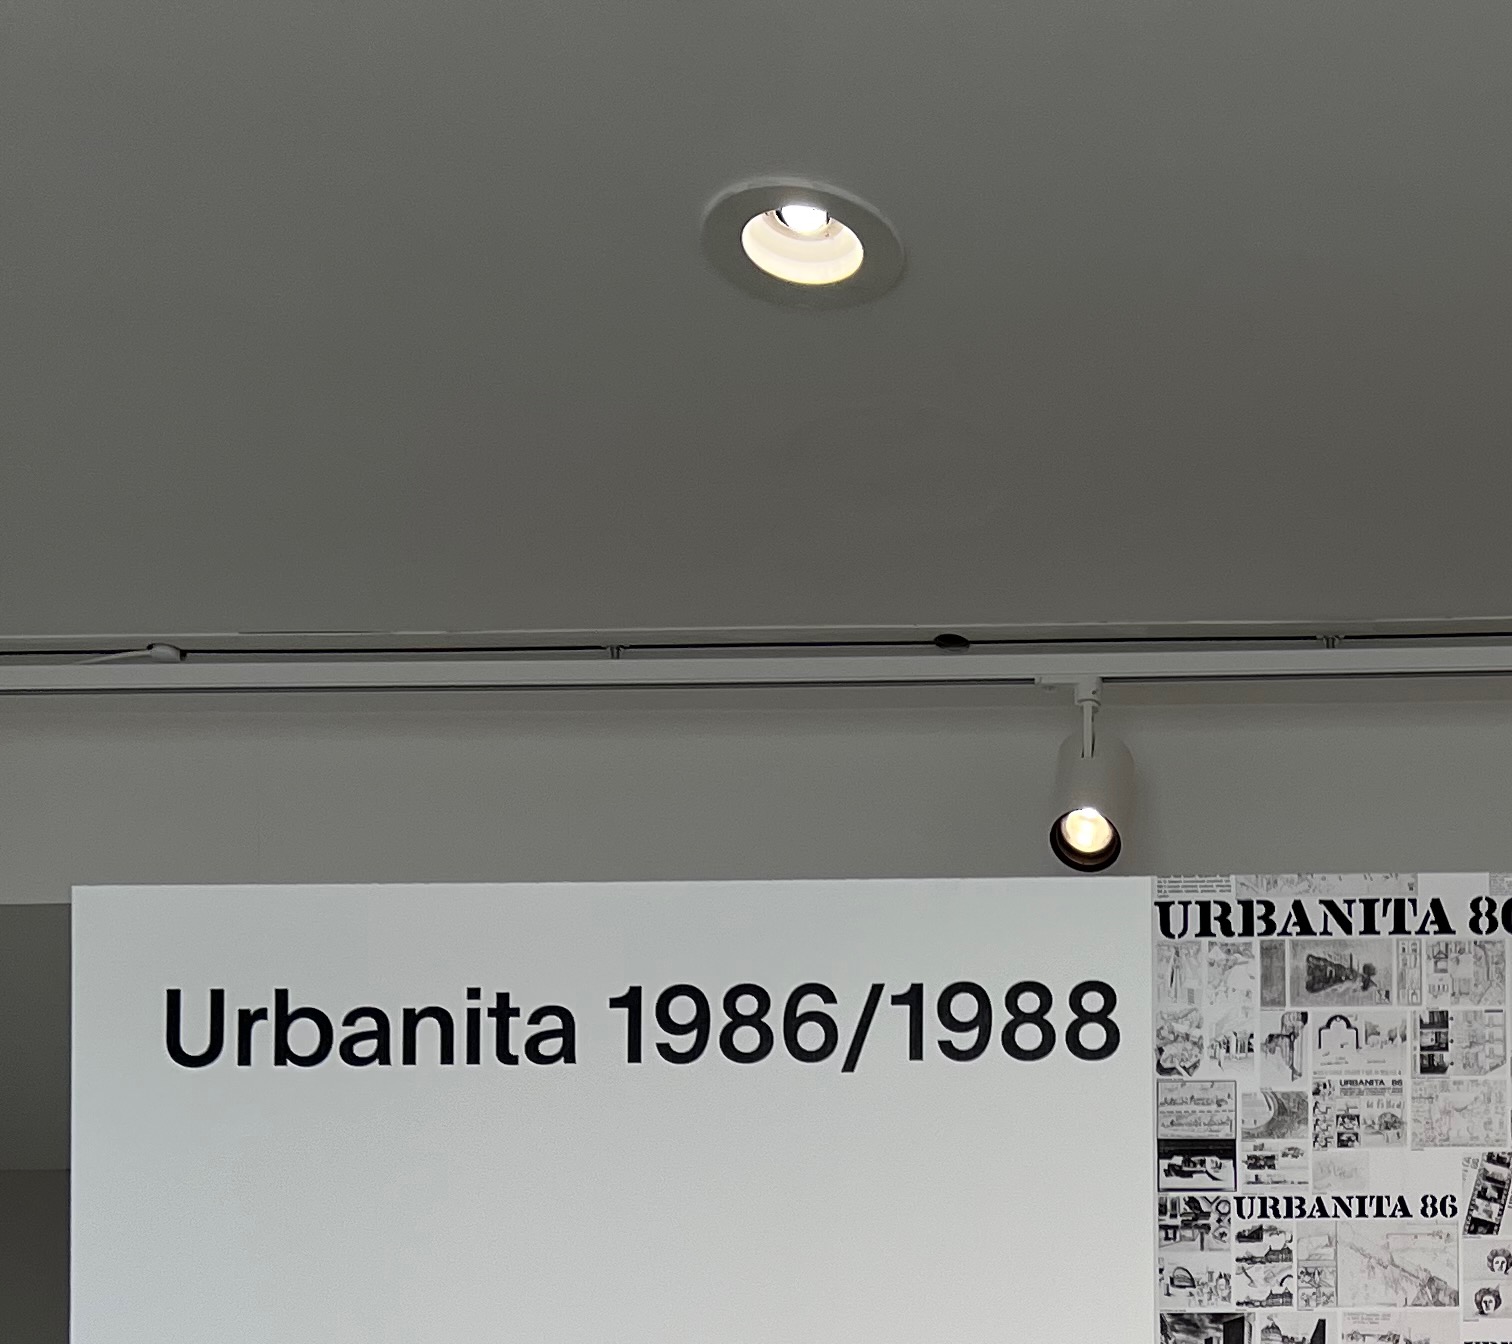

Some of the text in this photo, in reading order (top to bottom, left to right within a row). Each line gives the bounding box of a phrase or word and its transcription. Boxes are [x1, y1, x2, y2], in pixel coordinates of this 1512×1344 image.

[1153, 896, 1456, 939] URBANITA
[166, 980, 1120, 1074] Urbanita 1986/1988
[1235, 1194, 1457, 1220] URBANITA 86
